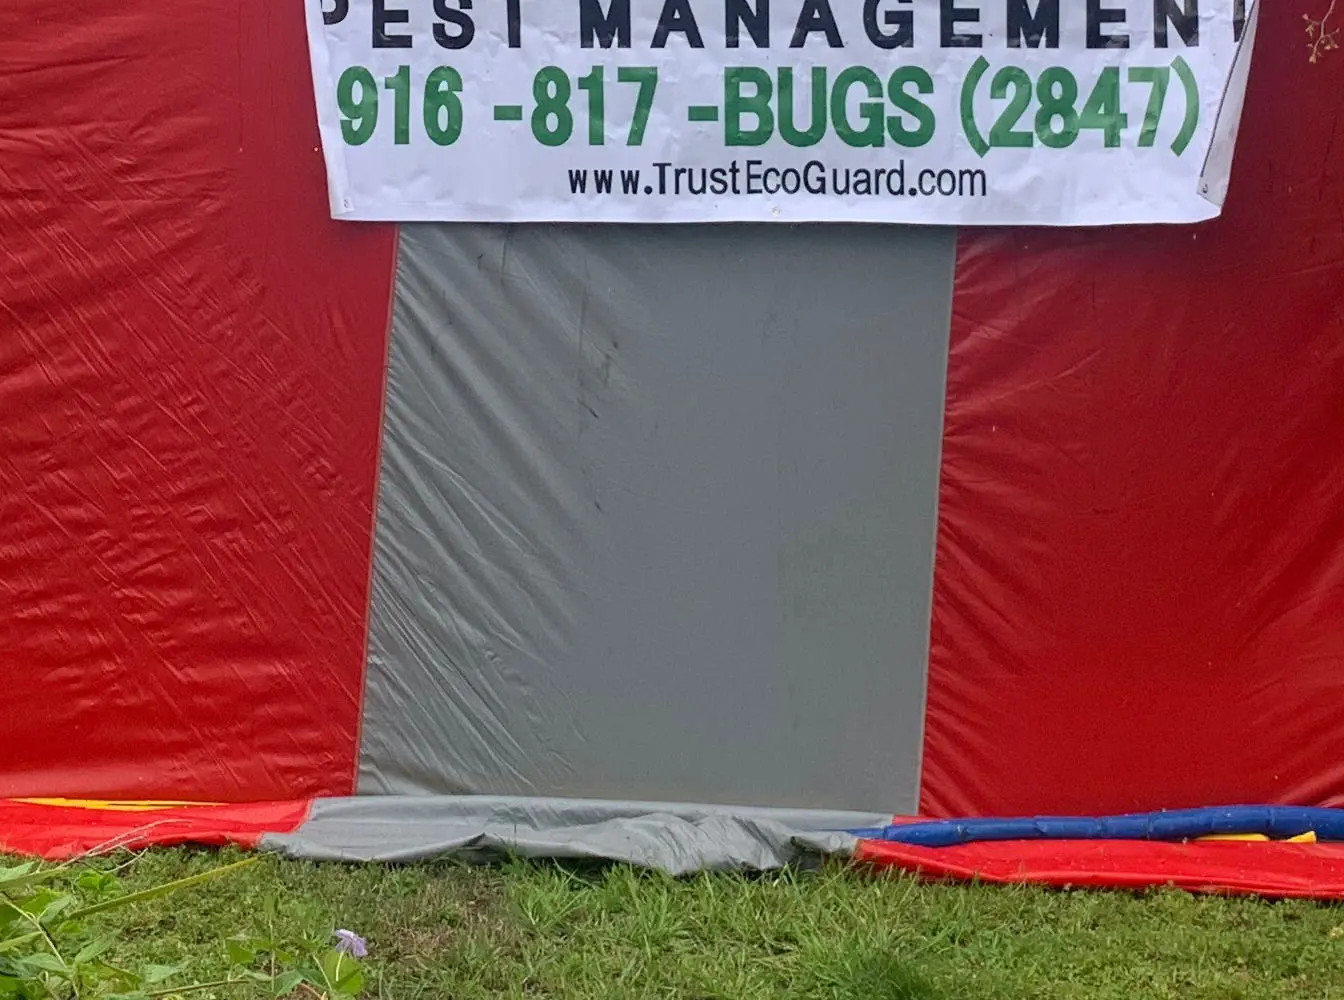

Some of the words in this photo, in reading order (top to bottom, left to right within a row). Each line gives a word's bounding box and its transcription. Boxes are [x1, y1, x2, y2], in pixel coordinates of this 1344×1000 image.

[336, 65, 464, 146] 916
[960, 55, 1200, 158] (2847)
[568, 160, 987, 196] www.TrustEcoGuard.com
